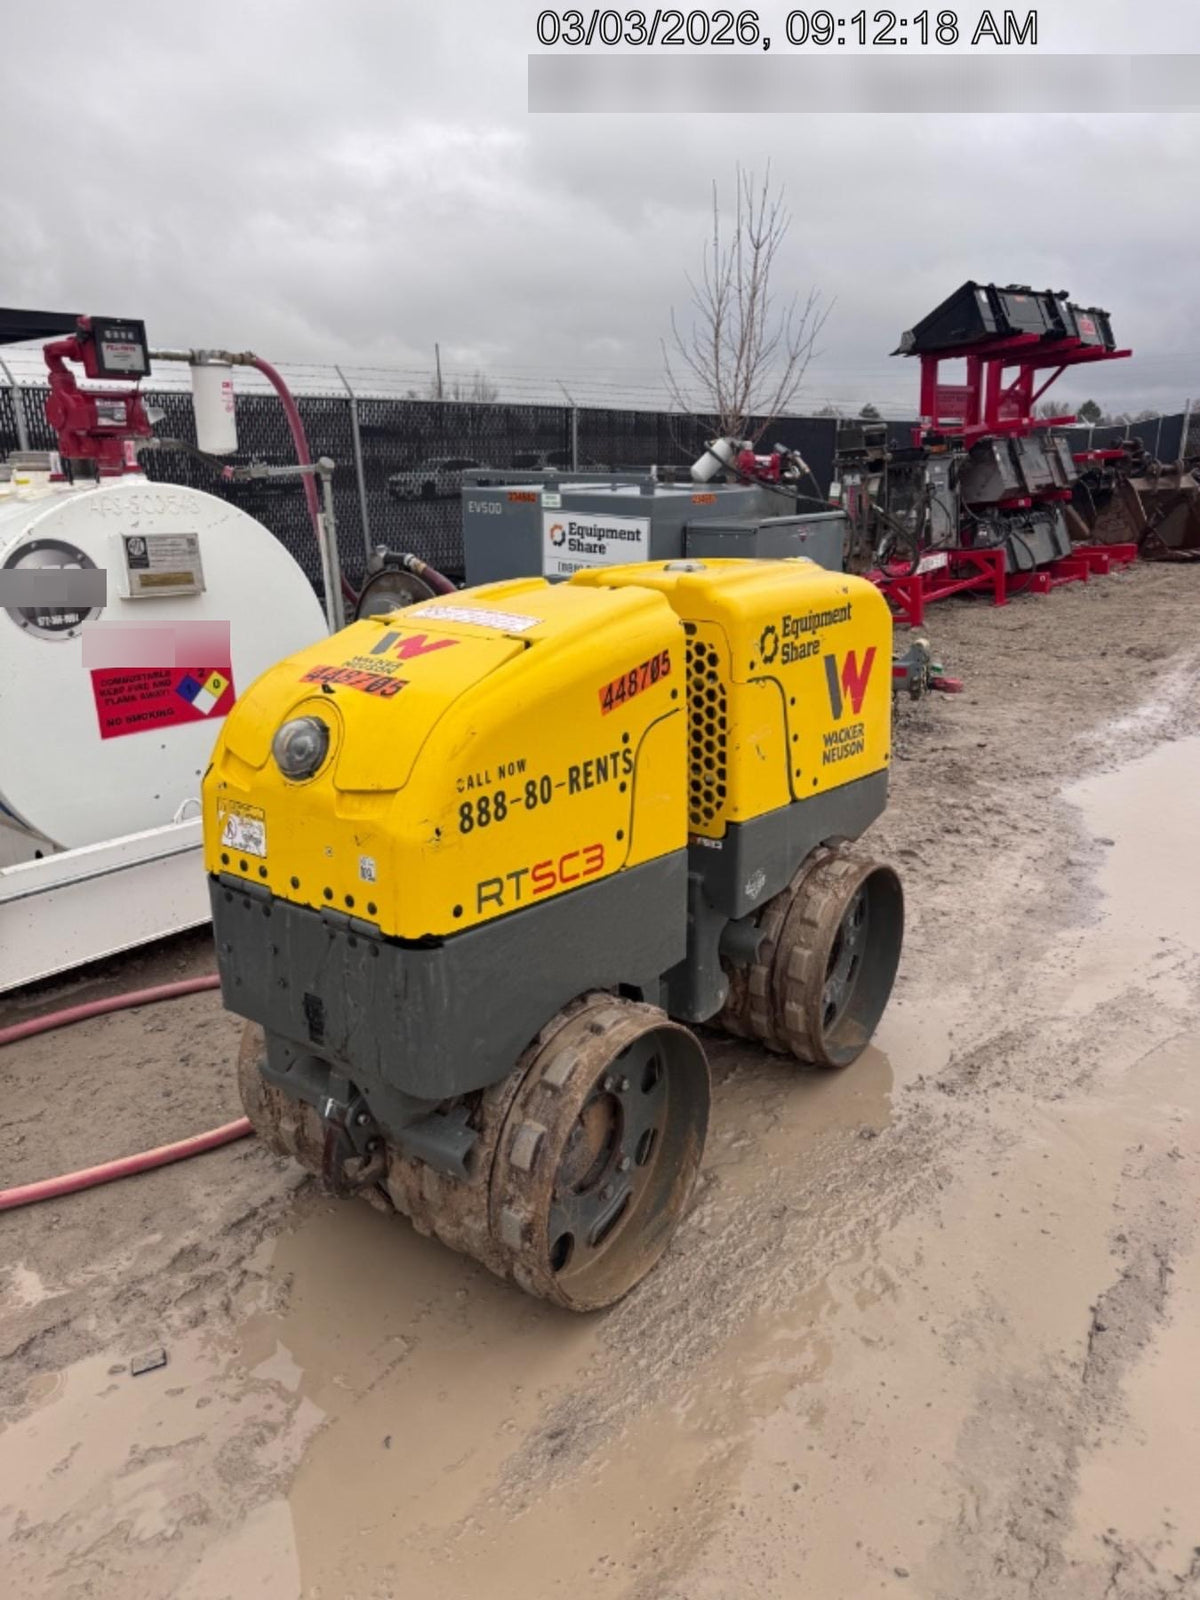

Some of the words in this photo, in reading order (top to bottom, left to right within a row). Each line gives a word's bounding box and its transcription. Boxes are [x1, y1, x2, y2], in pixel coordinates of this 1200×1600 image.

[568, 522, 642, 541] Equipment
[568, 539, 607, 555] Share
[782, 602, 852, 640] Equipment
[781, 640, 820, 665] Share
[306, 666, 410, 698] 448705
[601, 649, 671, 711] 448705
[107, 716, 122, 728] NO
[126, 706, 174, 723] SMOKING
[823, 723, 865, 747] WACKER
[822, 739, 865, 766] NEUSON
[456, 770, 492, 793] CALL
[498, 758, 527, 781] NOW
[459, 747, 633, 834] 888-80-RENTS
[476, 842, 604, 914] RTSC3
